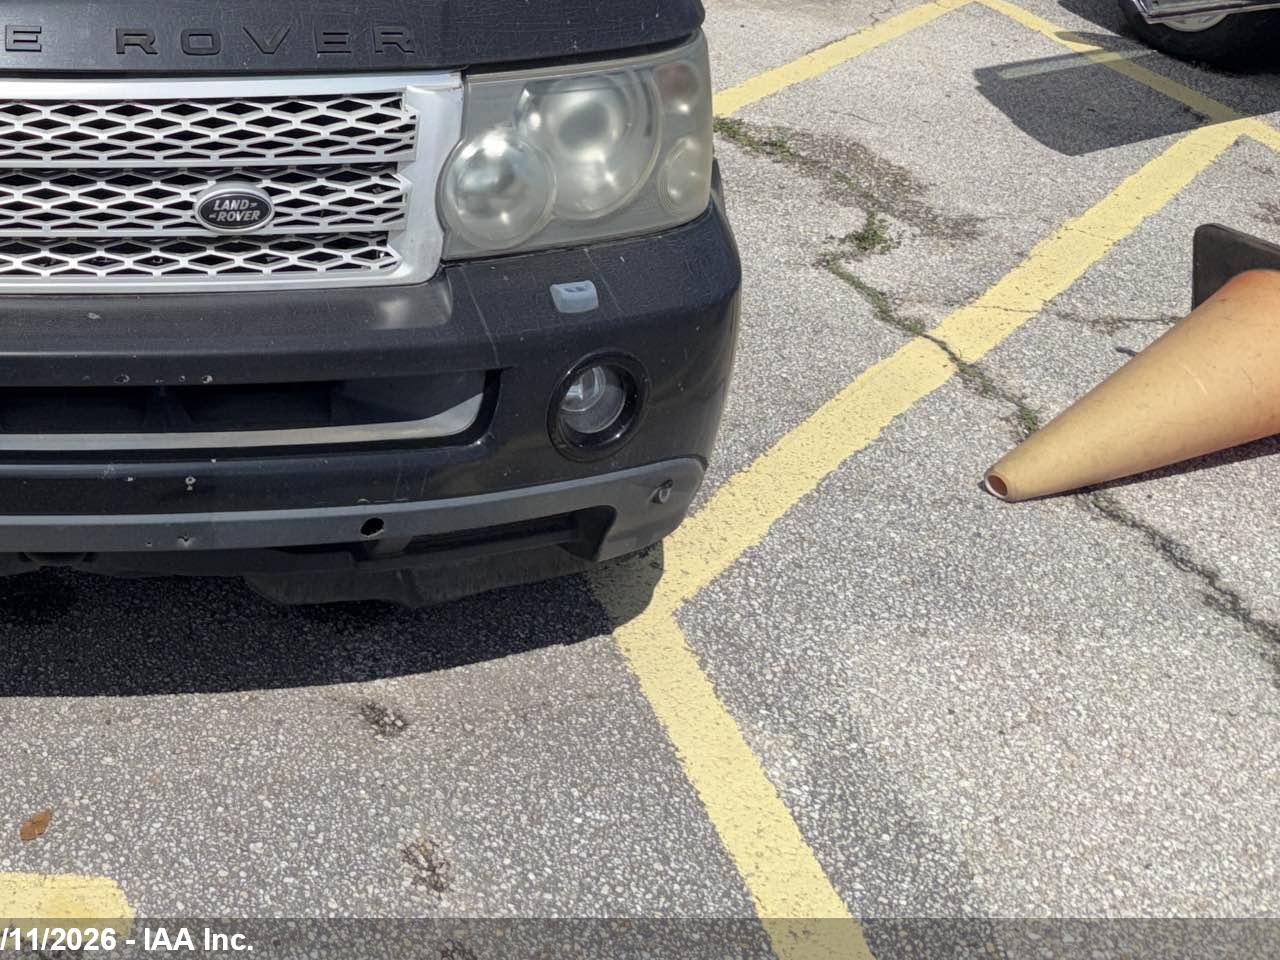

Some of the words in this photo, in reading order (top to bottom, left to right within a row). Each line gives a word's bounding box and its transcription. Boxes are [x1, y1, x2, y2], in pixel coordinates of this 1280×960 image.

[115, 26, 415, 55] ROVER
[213, 200, 249, 210] LAND
[217, 210, 260, 221] ROVER
